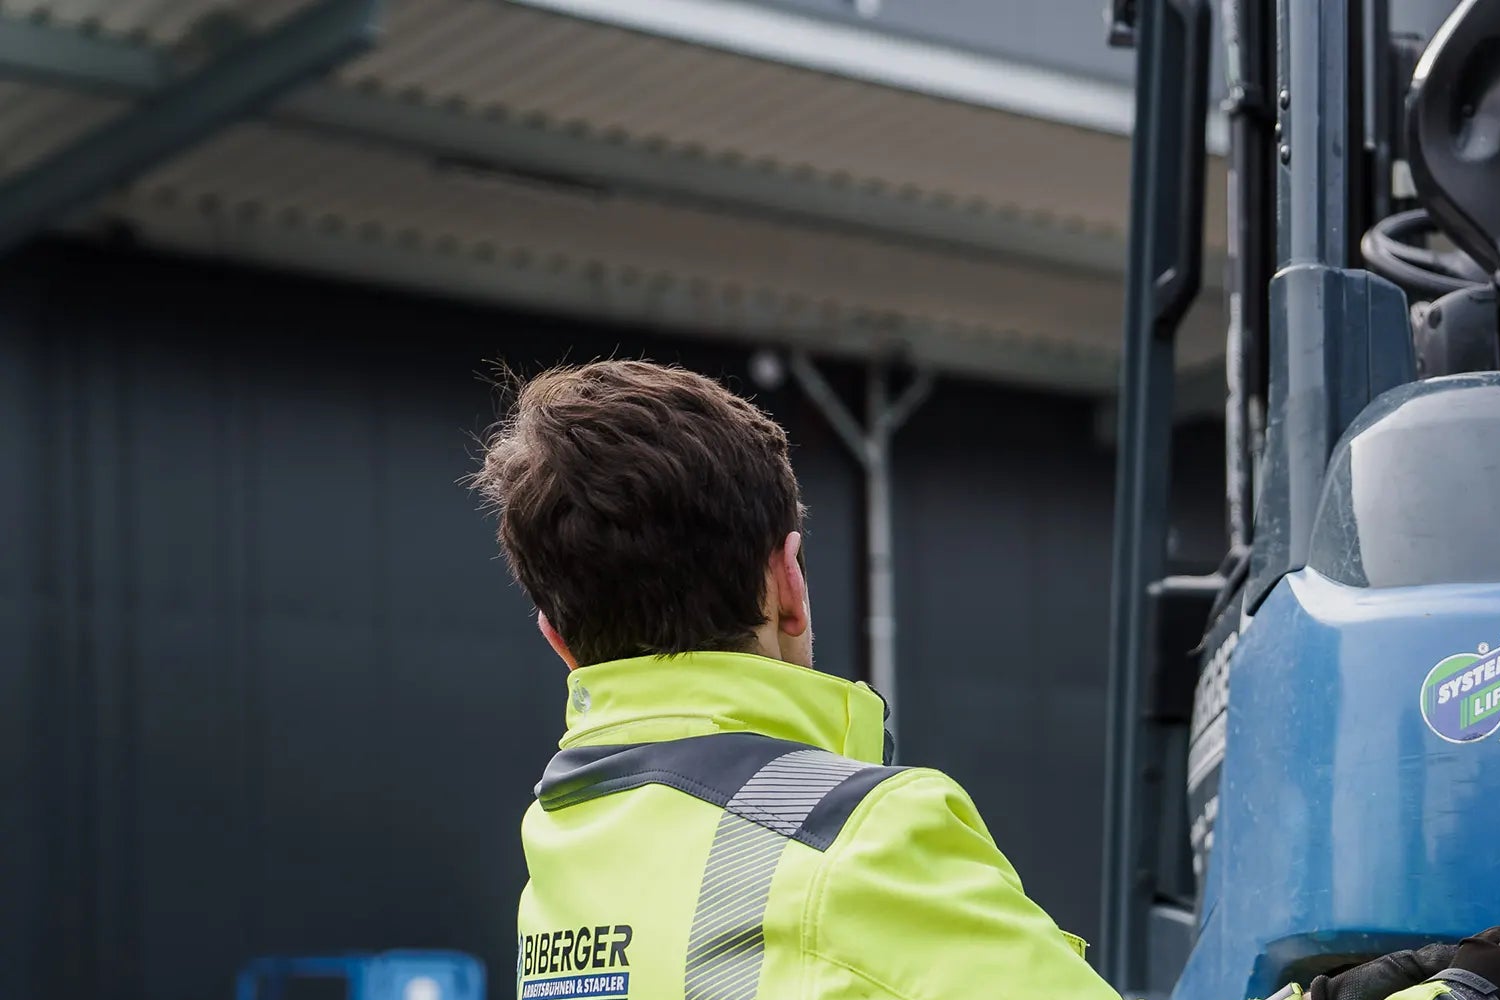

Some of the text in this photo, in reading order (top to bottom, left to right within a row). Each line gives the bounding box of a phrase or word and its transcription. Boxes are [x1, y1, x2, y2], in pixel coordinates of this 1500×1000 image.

[524, 925, 633, 976] BIBERGER
[523, 976, 624, 999] ARBEITSBÜHNEN & STAPLER
